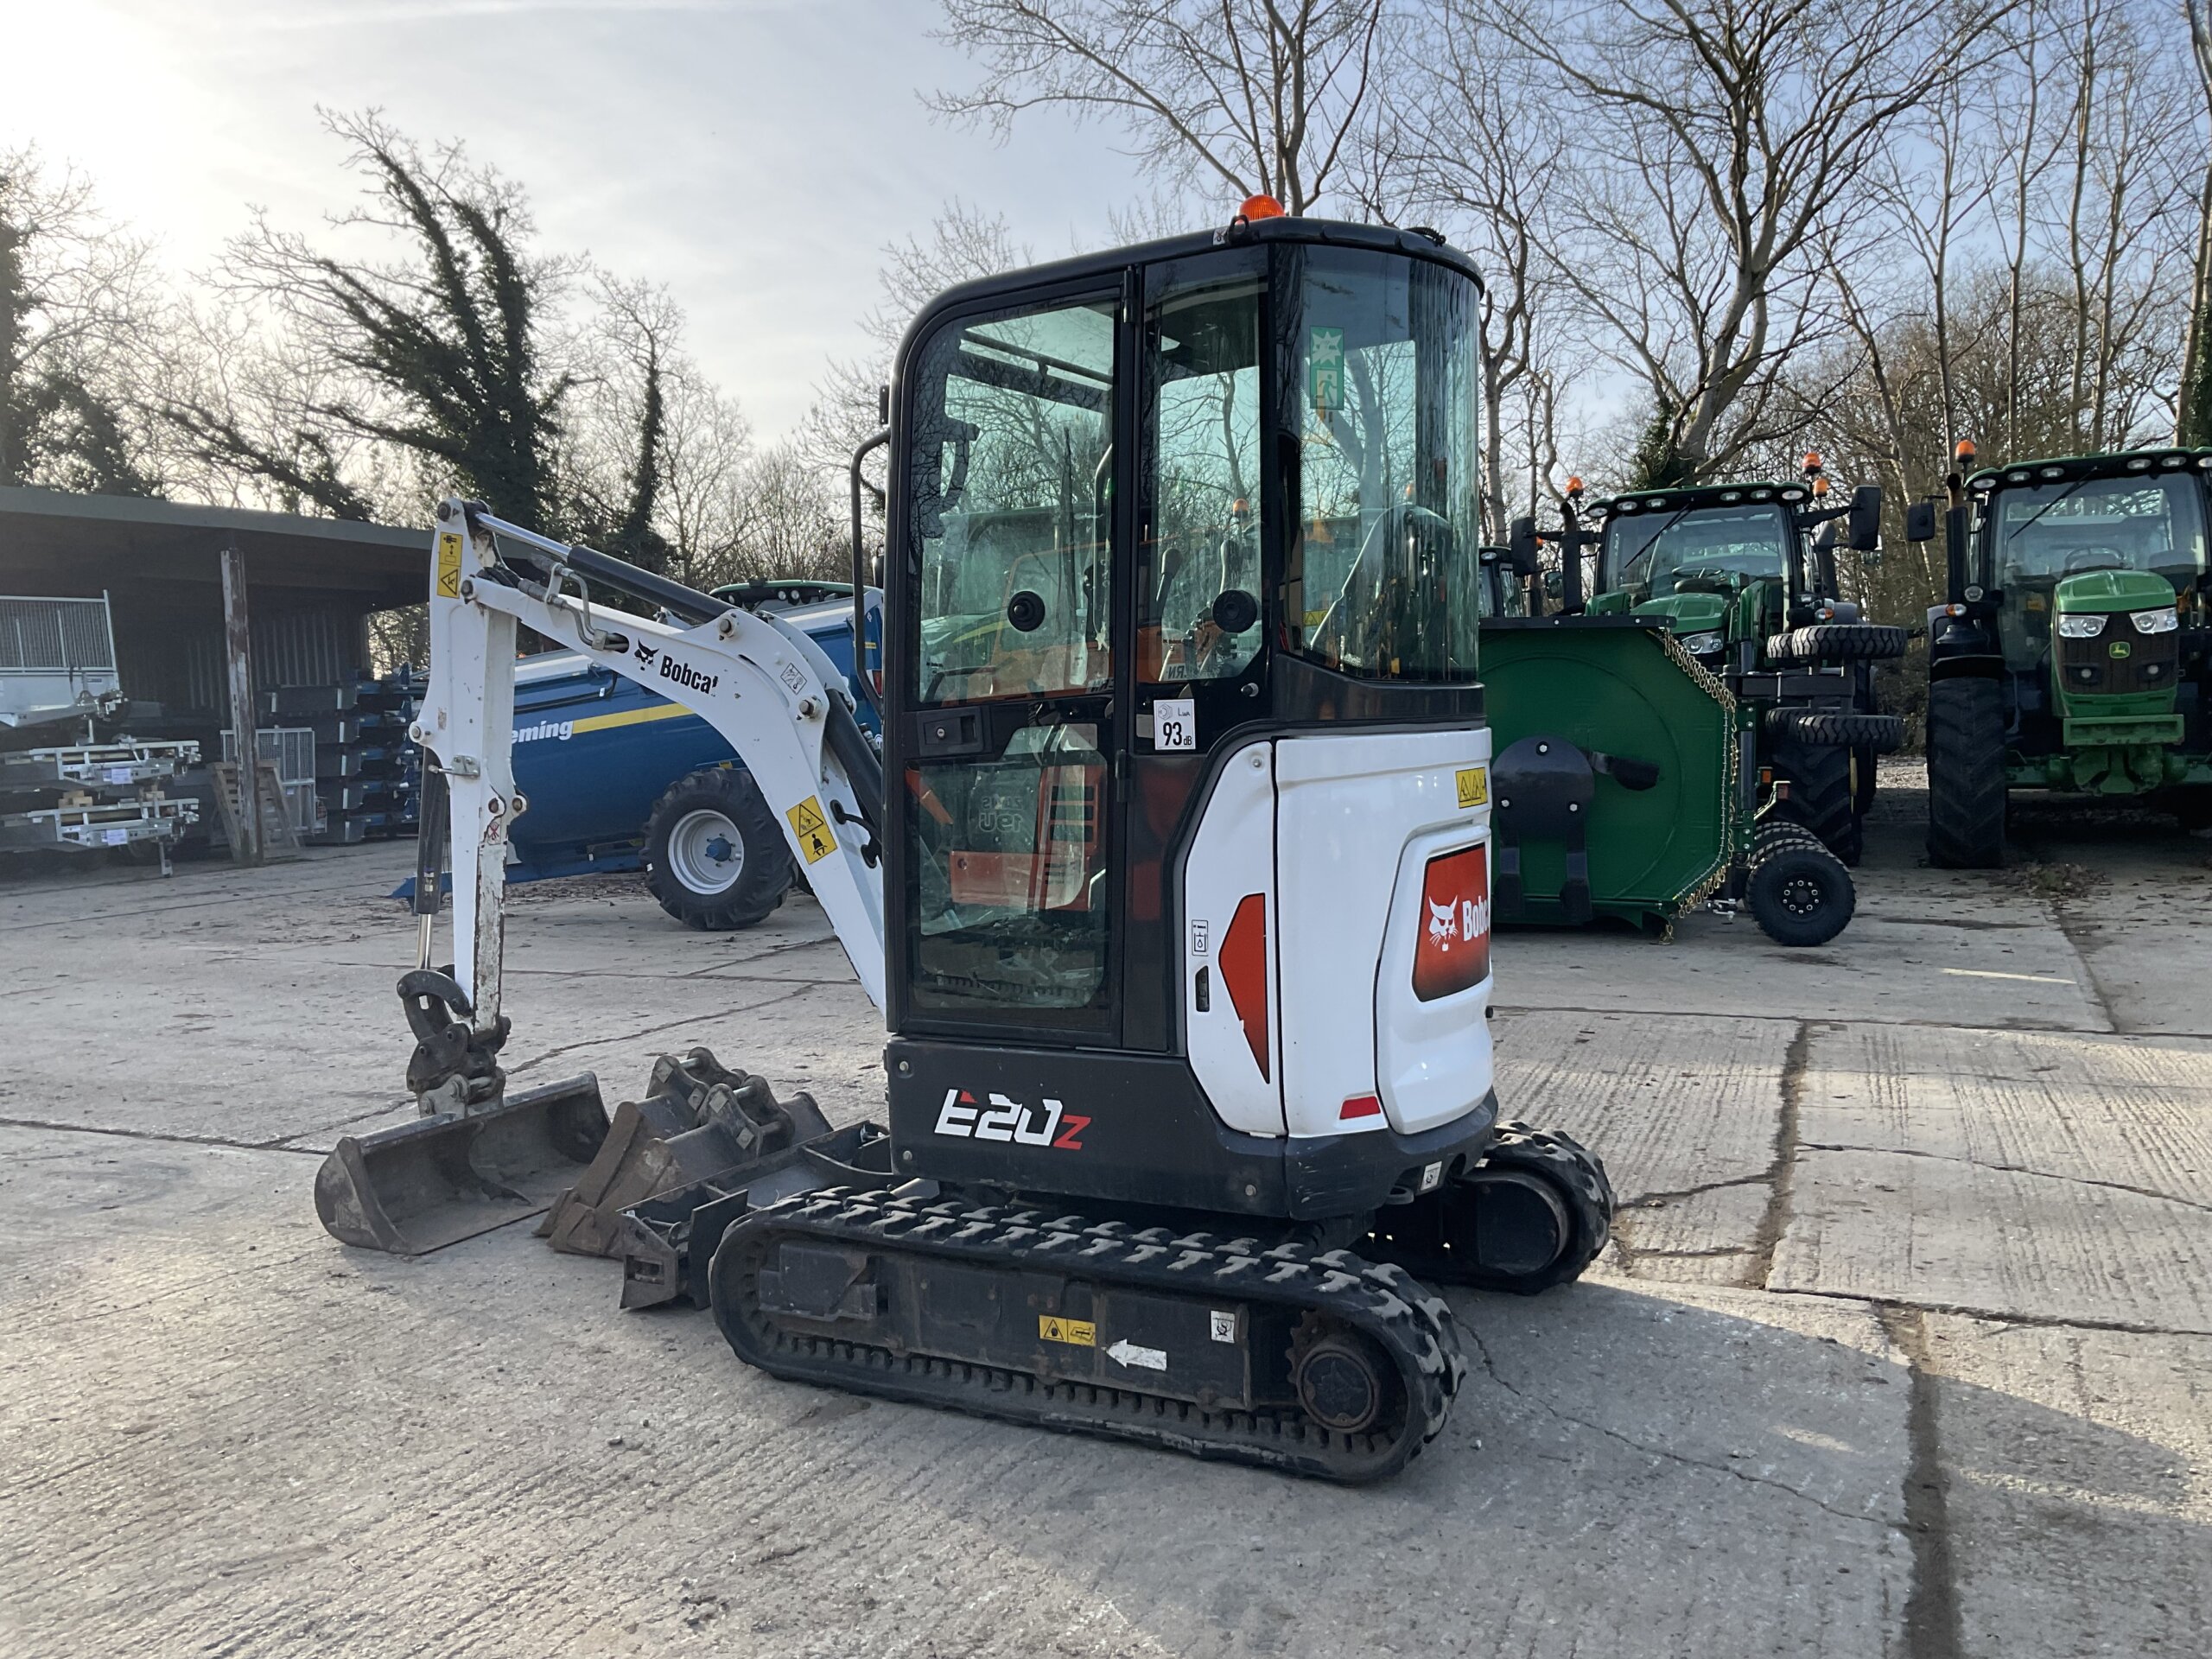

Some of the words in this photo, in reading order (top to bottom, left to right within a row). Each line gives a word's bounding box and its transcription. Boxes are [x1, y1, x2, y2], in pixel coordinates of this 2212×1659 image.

[659, 655, 719, 697] Bobcat
[512, 720, 574, 744] eming
[1162, 721, 1183, 747] 93
[1183, 734, 1192, 746] dB
